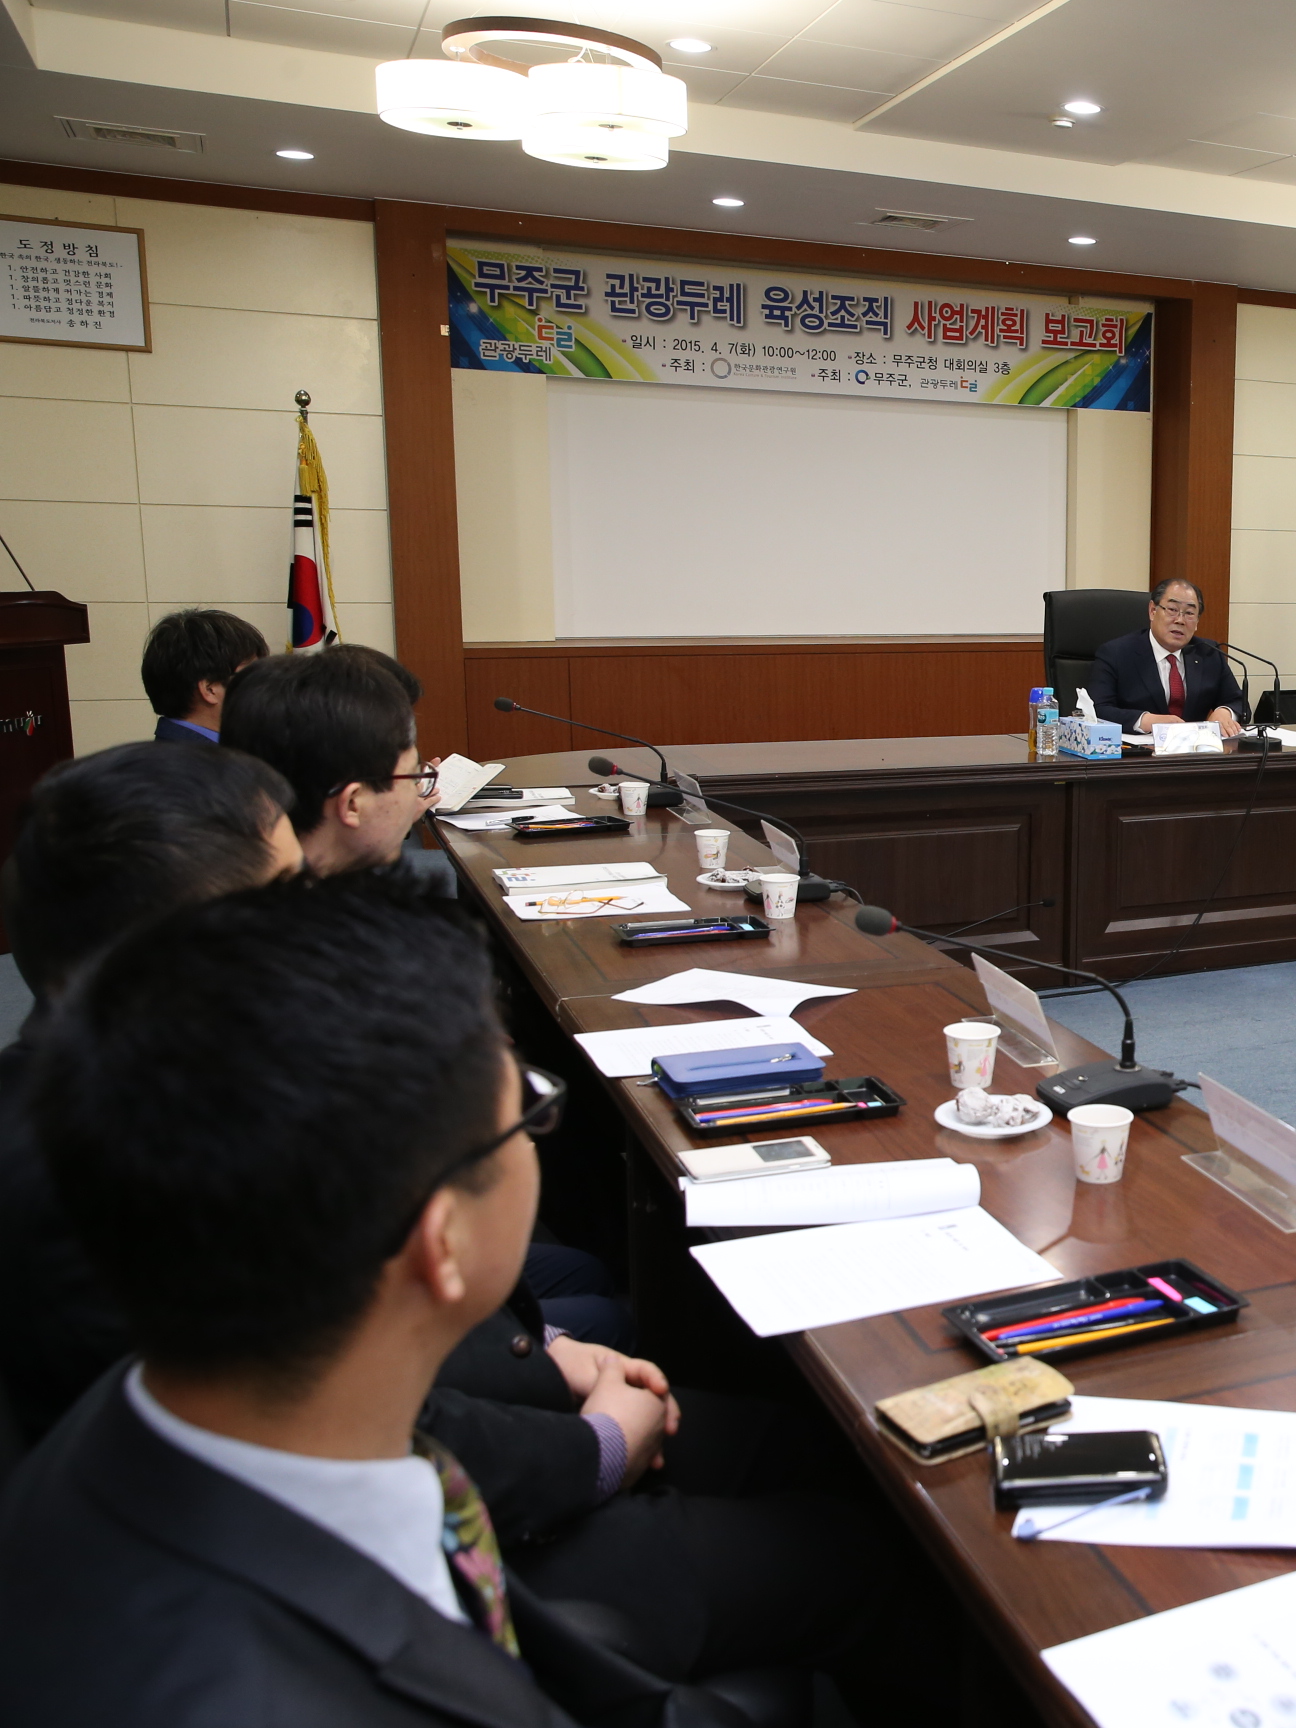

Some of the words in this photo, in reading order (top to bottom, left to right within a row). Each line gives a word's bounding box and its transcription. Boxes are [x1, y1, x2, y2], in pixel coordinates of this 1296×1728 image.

[20, 265, 59, 275] 안전하고
[62, 269, 90, 278] 건강한
[94, 272, 112, 280] 사회
[21, 275, 60, 284] 창의롭고
[95, 281, 113, 290] 문화
[21, 284, 60, 294] 알뜰하게
[23, 295, 62, 304] 따뜻하고
[66, 298, 93, 306] 정다운
[472, 259, 587, 313] 무주군
[604, 271, 743, 326] 관광두레
[760, 285, 892, 338] 육성조직
[905, 299, 1027, 348] 사업계획
[1041, 311, 1127, 354] 보고회
[24, 304, 62, 313] 아름답고
[66, 307, 94, 316] 청정한
[98, 310, 115, 318] 환경
[479, 339, 552, 364] 관광두레
[630, 334, 656, 350] 일시
[673, 338, 704, 354] 2015.
[710, 343, 725, 355] 4.
[728, 342, 756, 358] 7(화)
[762, 345, 837, 361] 10:00~12:00
[669, 358, 696, 374] 주최
[734, 363, 797, 376] 한국문화관광연구원
[853, 350, 877, 366] 장소
[892, 354, 938, 370] 무주군청
[944, 357, 989, 374] 대회의실
[994, 361, 1011, 376] 3층
[817, 368, 841, 383] 주최
[873, 372, 912, 389] 무주군,
[920, 378, 959, 390] 관광두레
